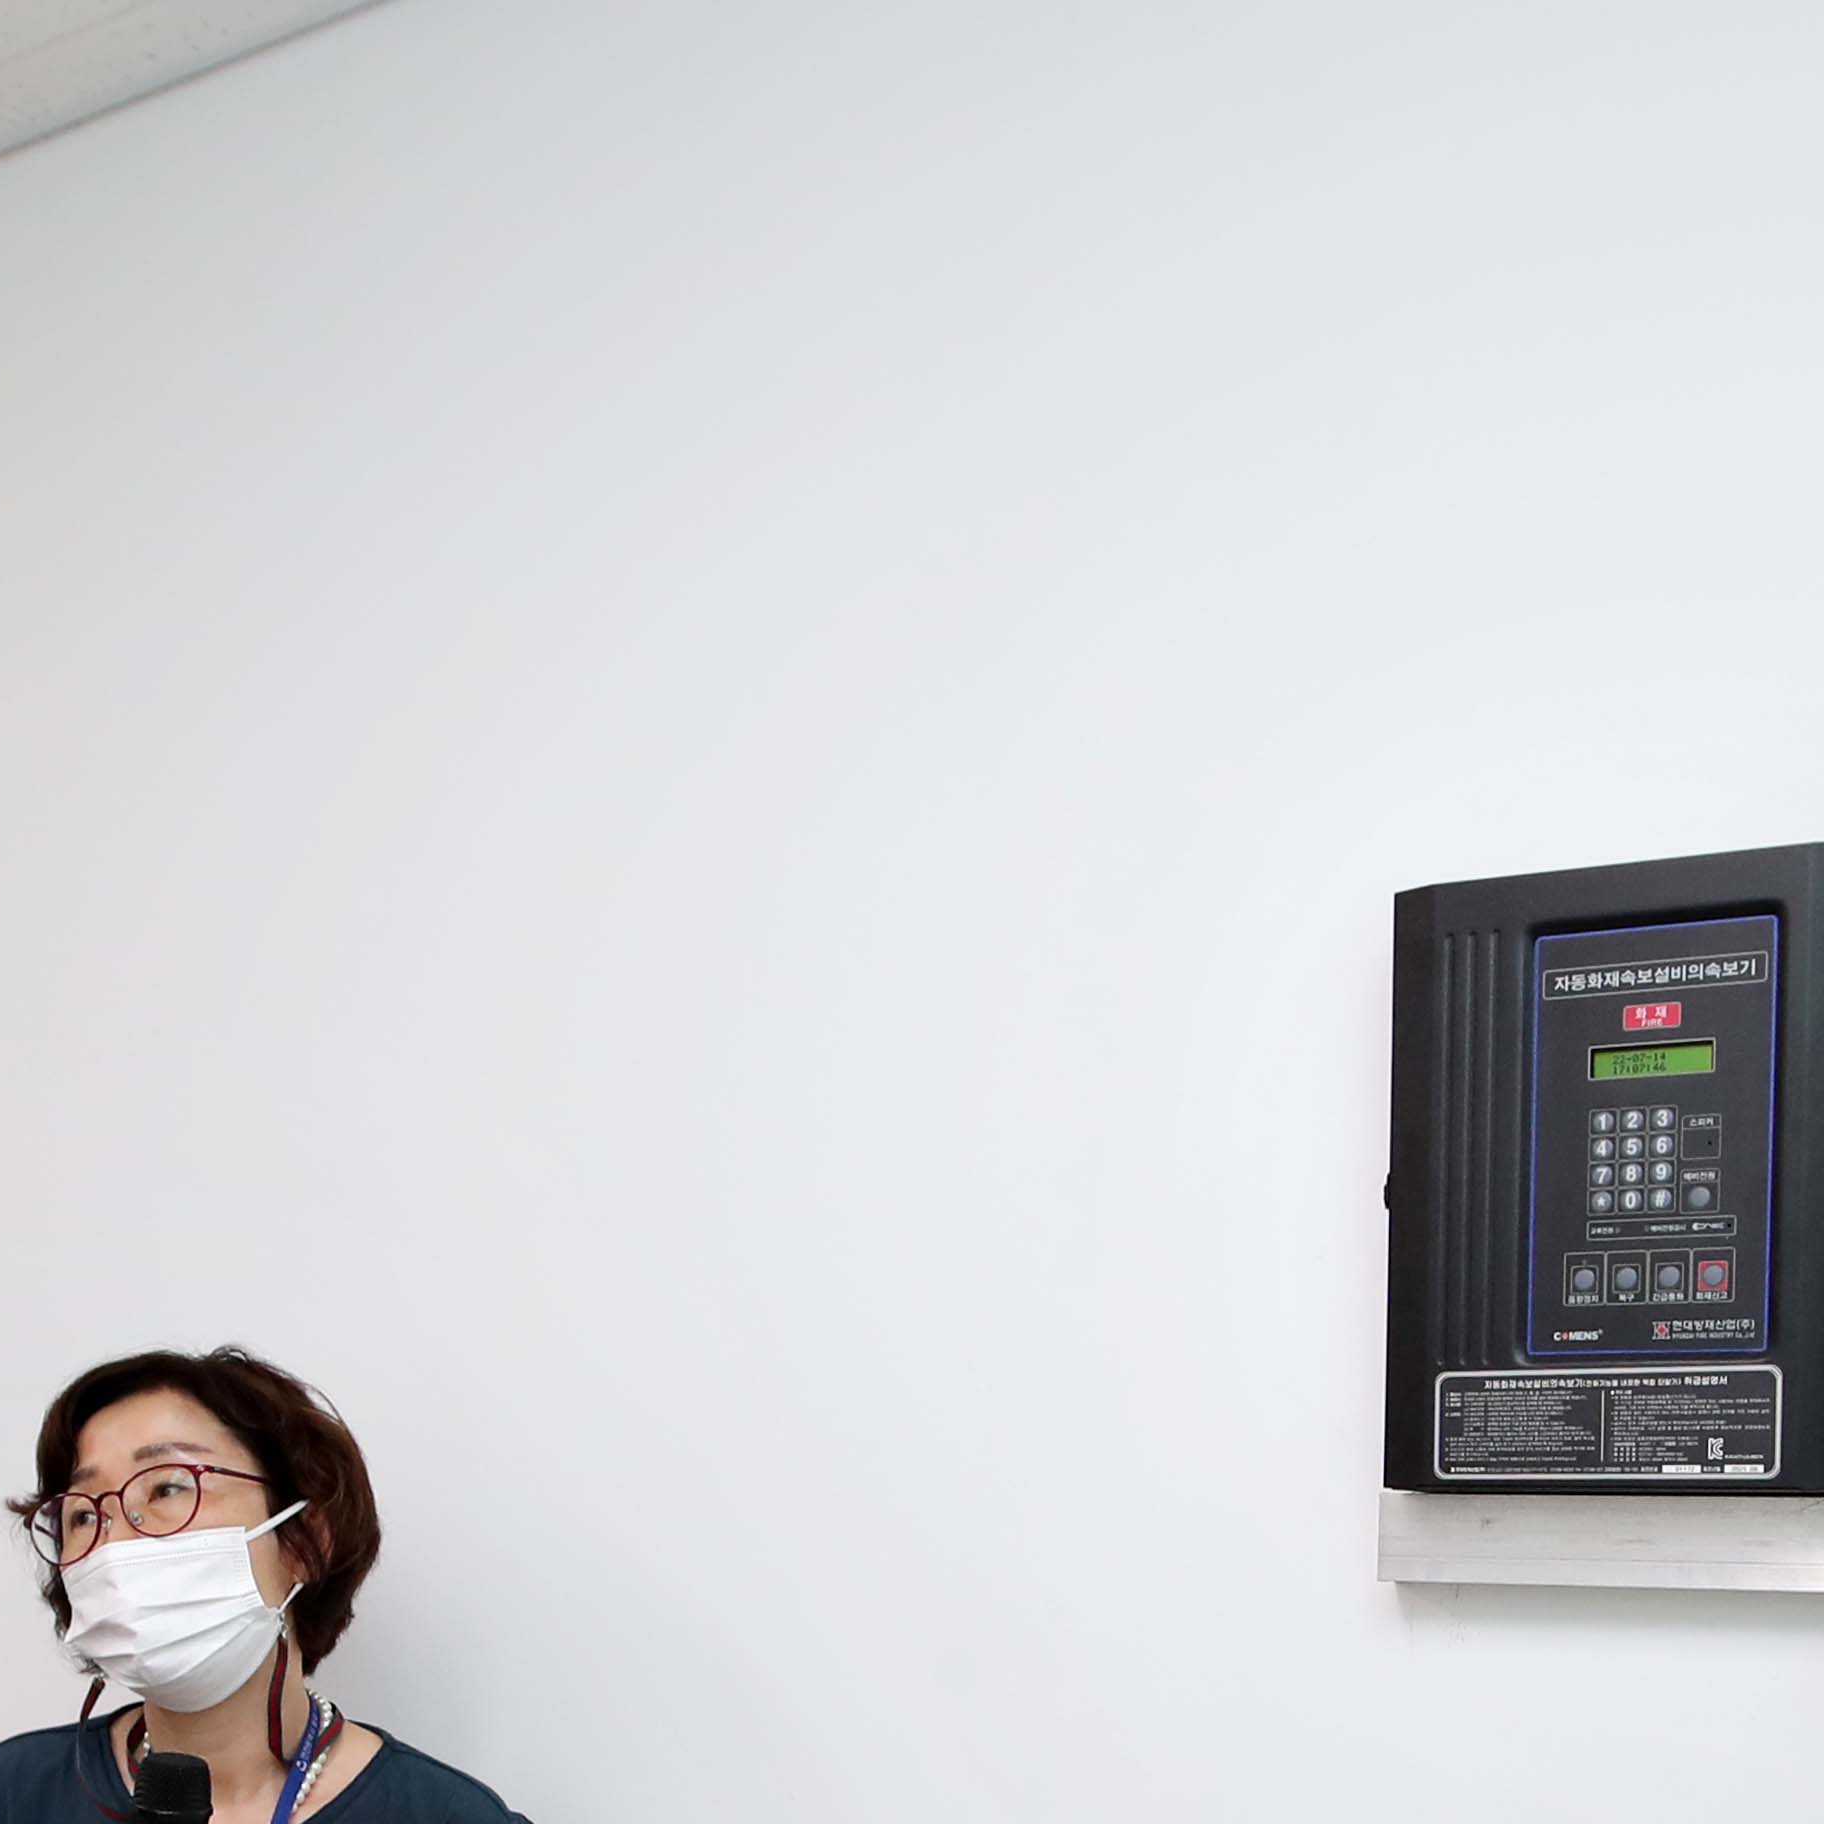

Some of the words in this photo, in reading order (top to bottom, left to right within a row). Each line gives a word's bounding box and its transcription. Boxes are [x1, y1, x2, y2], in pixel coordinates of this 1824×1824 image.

[1554, 958, 1756, 992] 자동화재속보설비의속보기
[1641, 1018, 1663, 1027] FIRE
[1598, 1112, 1606, 1131] 1
[1627, 1110, 1638, 1129] 2
[1657, 1109, 1668, 1127] 3
[1690, 1116, 1714, 1127] 스피커
[1596, 1138, 1606, 1157] 4
[1626, 1137, 1637, 1155] 5
[1656, 1135, 1667, 1153] 6
[1596, 1167, 1607, 1184] 7
[1626, 1164, 1637, 1182] 8
[1655, 1163, 1667, 1180] 9
[1626, 1191, 1636, 1209] 0
[1672, 1318, 1755, 1331] 현대방재산업(주)
[1683, 1375, 1728, 1386] 취급설명서
